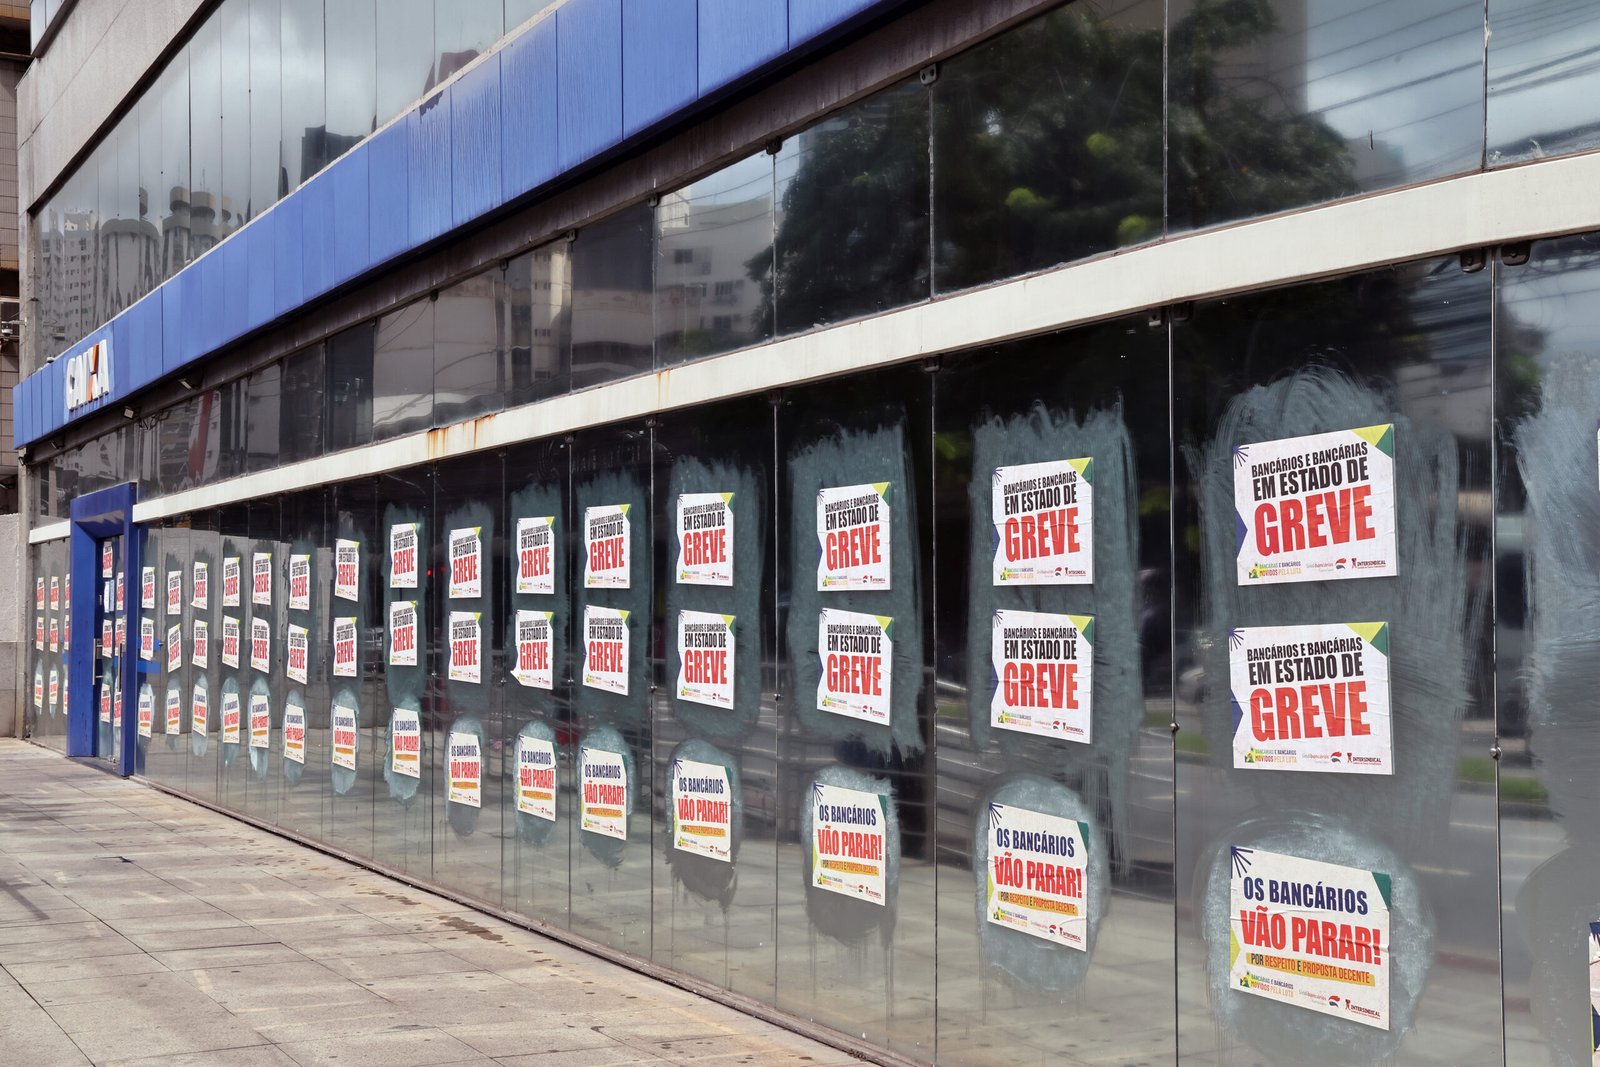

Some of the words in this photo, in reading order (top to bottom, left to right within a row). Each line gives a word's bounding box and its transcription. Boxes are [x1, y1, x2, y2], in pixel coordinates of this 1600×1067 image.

[1252, 455, 1303, 477] BANCÁRIOS
[1306, 454, 1310, 467] E
[1313, 442, 1367, 463] BANCÁRIAS
[1004, 478, 1037, 495] BANCÁRIOS
[1038, 478, 1041, 489] E
[1043, 471, 1076, 488] BANCÁRIAS
[1253, 475, 1276, 501] EM
[1280, 462, 1342, 494] ESTADO
[1347, 457, 1368, 482] DE
[1005, 493, 1019, 515] EM
[1022, 487, 1060, 512] ESTADO
[1064, 484, 1076, 505] DE
[684, 516, 692, 531] EM
[694, 512, 715, 529] ESTADO
[718, 511, 725, 526] DE
[826, 512, 836, 530] EM
[839, 507, 867, 527] ESTADO
[869, 504, 879, 522] DE
[1255, 485, 1375, 556] GREVE
[684, 529, 726, 566] GREVE
[826, 524, 881, 571] GREVE
[1005, 507, 1080, 562] GREVE
[453, 554, 477, 584] GREVE
[521, 546, 549, 579] GREVE
[590, 537, 624, 572] GREVE
[685, 633, 693, 647] EM
[695, 633, 717, 647] ESTADO
[719, 633, 726, 647] DE
[828, 635, 838, 651] EM
[840, 635, 869, 653] ESTADO
[871, 637, 881, 653] DE
[1004, 626, 1037, 639] BANCÁRIOS
[1038, 628, 1041, 638] E
[1043, 626, 1077, 639] BANCÁRIAS
[453, 640, 477, 666] GREVE
[520, 642, 548, 670] GREVE
[589, 641, 623, 673] GREVE
[1004, 640, 1018, 659] EM
[1022, 640, 1060, 659] ESTADO
[1064, 640, 1077, 659] DE
[1247, 644, 1298, 662] BANCÁRIOS
[1301, 644, 1305, 655] E
[1308, 637, 1362, 655] BANCÁRIAS
[685, 650, 727, 684] GREVE
[827, 654, 881, 696] GREVE
[1249, 662, 1271, 685] EM
[1275, 654, 1337, 683] ESTADO
[1342, 652, 1363, 678] DE
[1004, 662, 1078, 709] GREVE
[1250, 681, 1370, 742] GREVE
[585, 764, 591, 777] OS
[593, 763, 620, 779] BANCÁRIOS
[679, 777, 687, 792] OS
[689, 776, 723, 794] BANCÁRIOS
[584, 780, 598, 803] VÃO
[599, 784, 624, 806] PARAR!
[678, 795, 694, 821] VÃO
[697, 799, 728, 823] PARAR!
[820, 805, 829, 821] OS
[831, 804, 876, 825] BANCÁRIOS
[818, 825, 839, 855] VÃO
[842, 831, 882, 861] PARAR!
[997, 828, 1010, 848] OS
[1013, 831, 1074, 858] BANCÁRIOS
[994, 851, 1023, 888] VÃO
[1027, 860, 1082, 898] PARAR!
[1244, 876, 1264, 901] OS
[1269, 879, 1368, 915] BANCÁRIOS
[1240, 905, 1286, 950] VÃO
[1292, 917, 1381, 965] PARAR!
[1251, 953, 1264, 965] POR
[1265, 955, 1295, 970] RESPEITO
[1297, 961, 1301, 972] E
[1303, 961, 1337, 977] PROPOSTA
[1339, 967, 1370, 983] DECENTE
